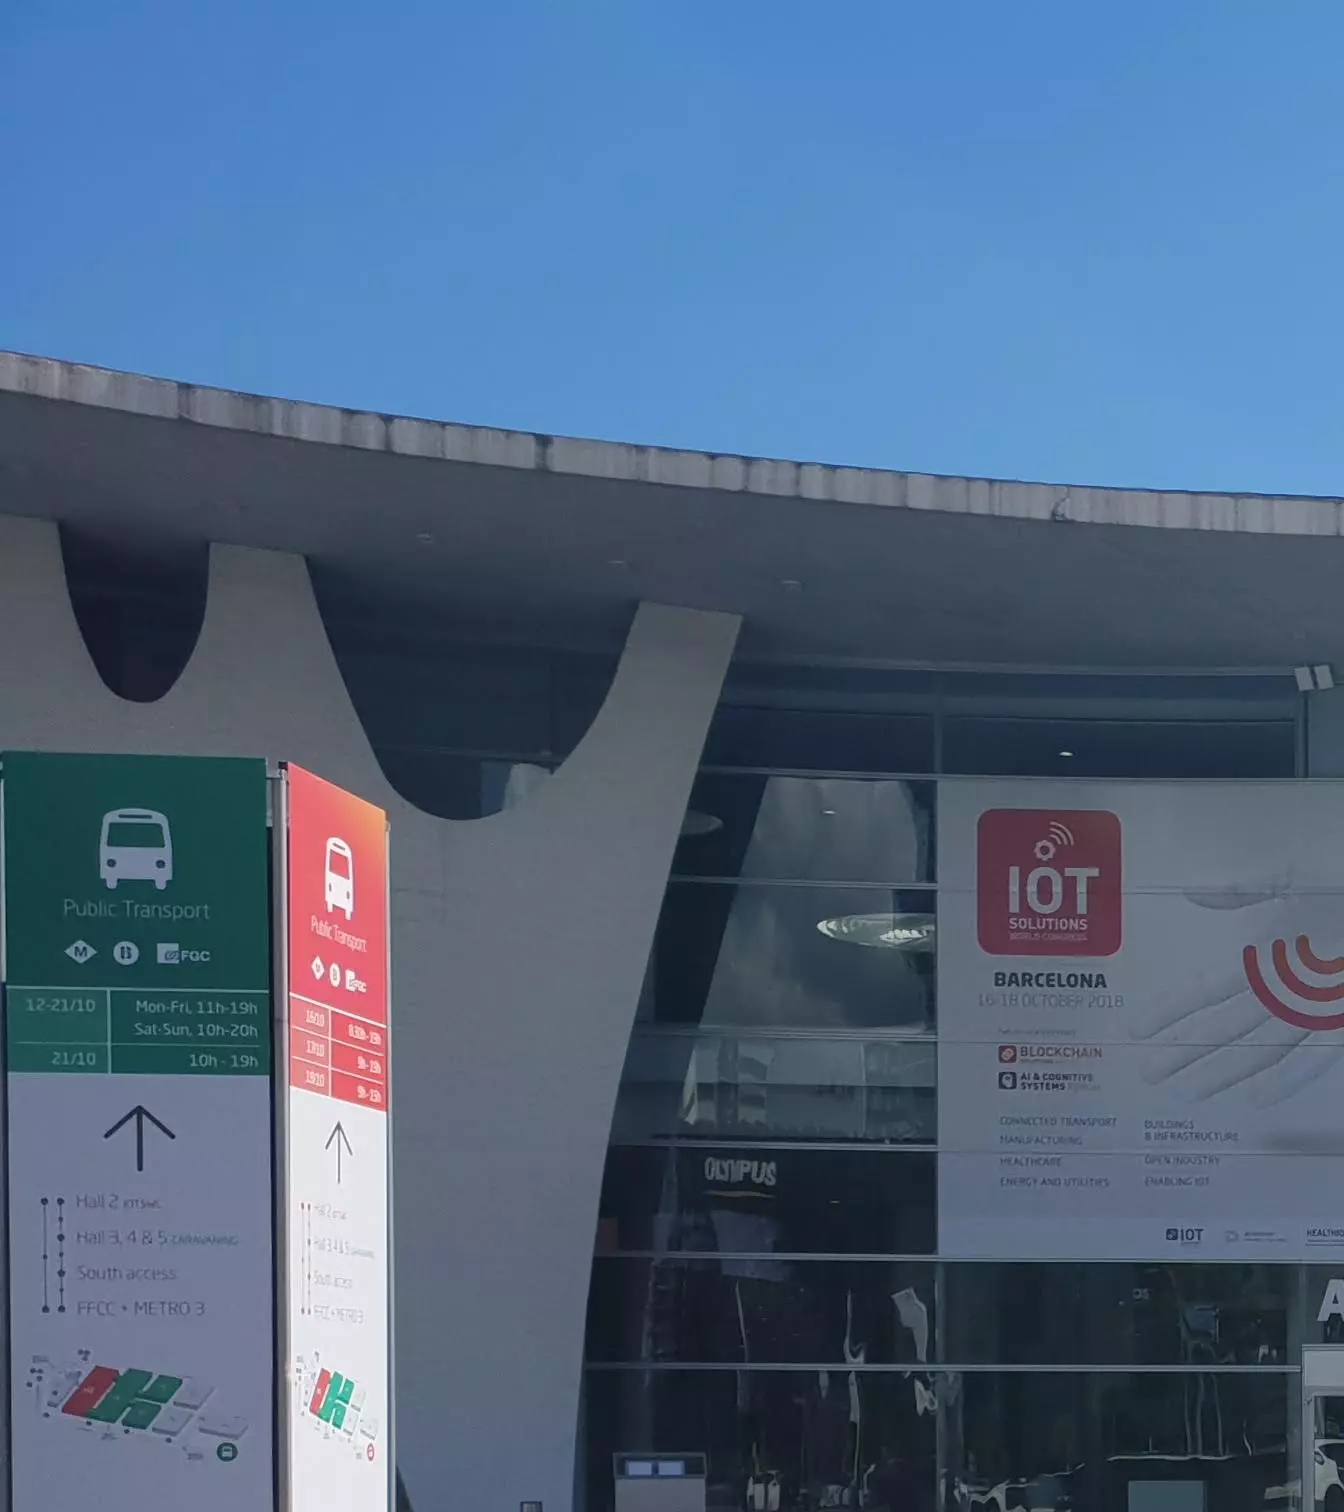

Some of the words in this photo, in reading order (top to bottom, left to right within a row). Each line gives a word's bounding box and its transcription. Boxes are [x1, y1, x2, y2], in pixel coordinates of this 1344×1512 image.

[1009, 866, 1099, 914] IOT
[63, 898, 118, 918] Public
[122, 899, 211, 921] Transport
[1009, 917, 1089, 930] SOLUTIONS
[181, 950, 211, 962] FGC
[994, 972, 1108, 989] BARCELONA
[26, 999, 96, 1012] 12-21/10
[197, 1023, 258, 1037] 10h-20h
[52, 1052, 97, 1066] 21/10
[190, 1054, 218, 1068] 10h
[232, 1054, 259, 1068] 19h
[1020, 1046, 1103, 1059] BLOCKCHAIN
[75, 1194, 105, 1209] Hall
[75, 1230, 105, 1246] Hall
[127, 1230, 137, 1245] 4
[76, 1264, 122, 1281] South
[126, 1268, 178, 1281] access
[134, 1300, 191, 1315] METRO
[196, 1301, 206, 1316] 3
